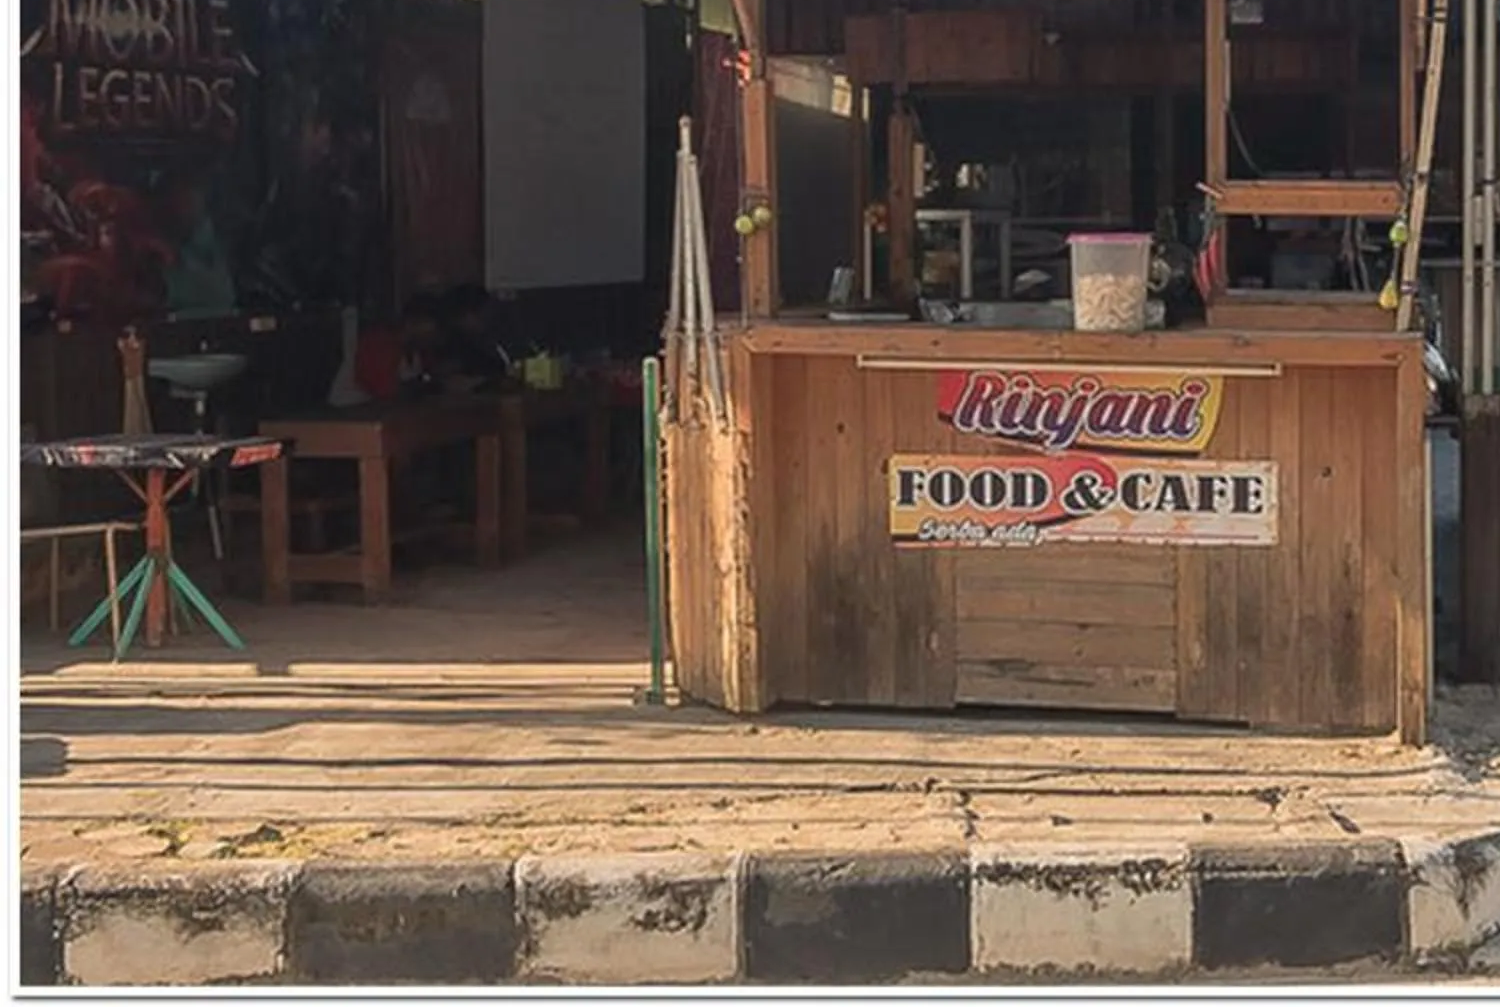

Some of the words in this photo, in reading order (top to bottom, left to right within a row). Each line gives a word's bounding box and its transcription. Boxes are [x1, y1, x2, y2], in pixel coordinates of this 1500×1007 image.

[53, 62, 239, 135] LEGENDS
[955, 371, 1207, 450] Rinjani
[896, 468, 1050, 509] FOOD
[1062, 470, 1117, 513] &
[1119, 471, 1264, 515] CAFE
